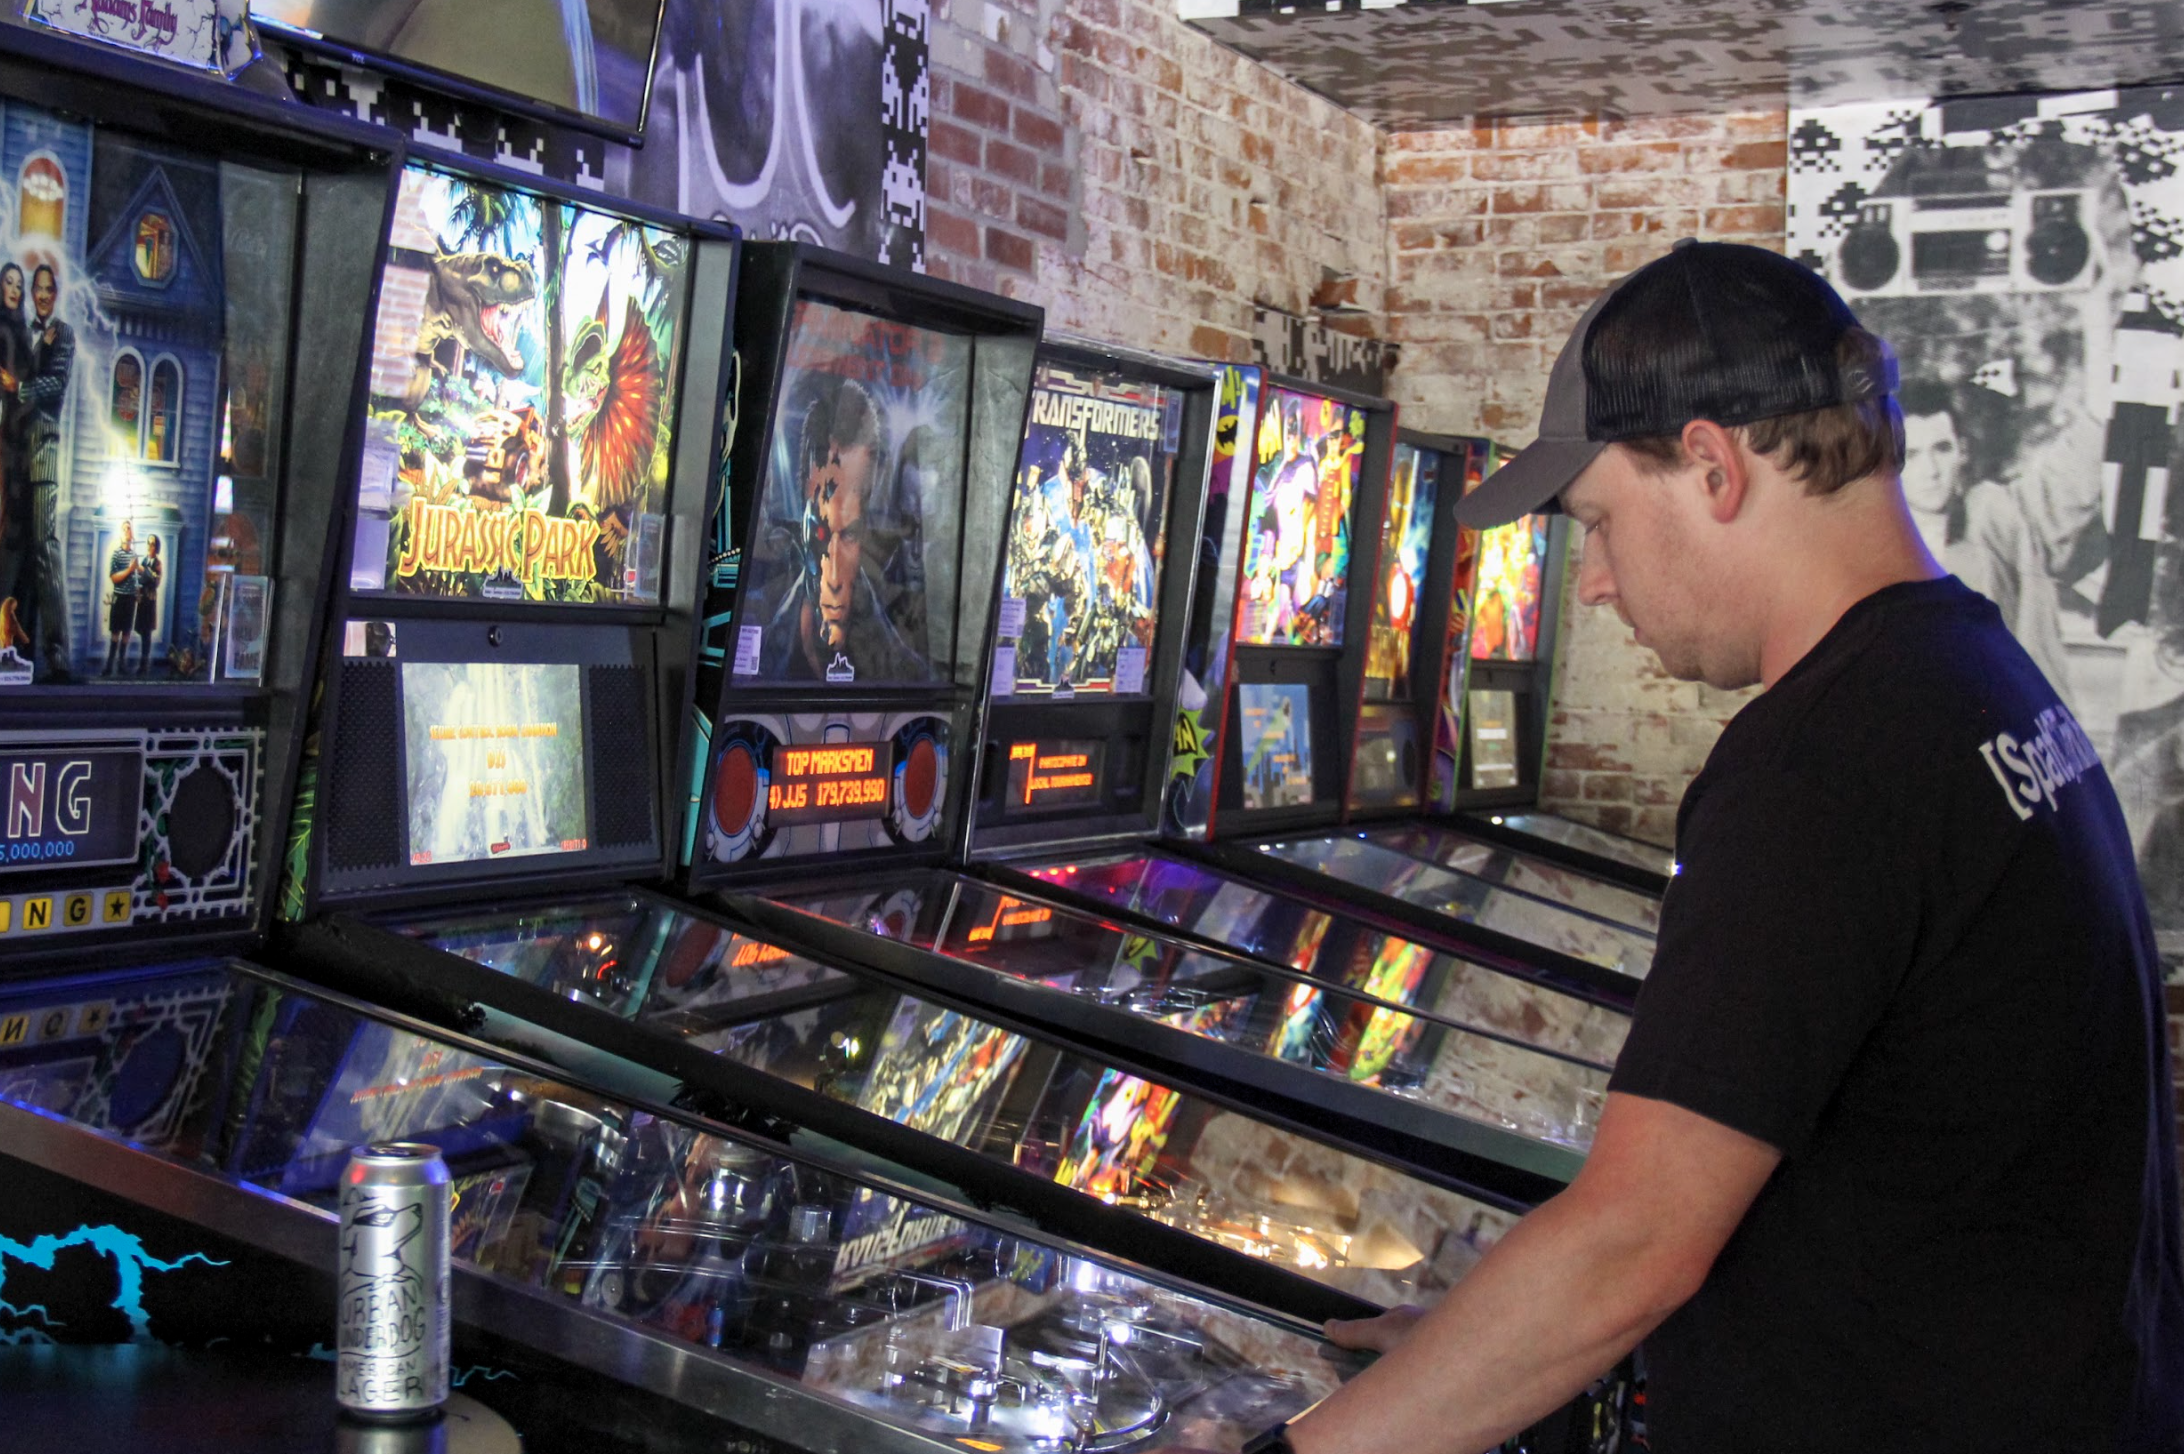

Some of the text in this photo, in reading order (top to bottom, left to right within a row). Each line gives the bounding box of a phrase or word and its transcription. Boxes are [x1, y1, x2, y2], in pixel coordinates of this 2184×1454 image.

[1032, 389, 1161, 450] RANSFORMERS
[398, 497, 521, 577] JURASSIC
[521, 508, 601, 583] PARK
[786, 748, 874, 776] TOP MARKSMEN
[816, 778, 885, 807] 179,739,990
[342, 1286, 418, 1325] URBAN
[340, 1376, 424, 1402] LAGER
